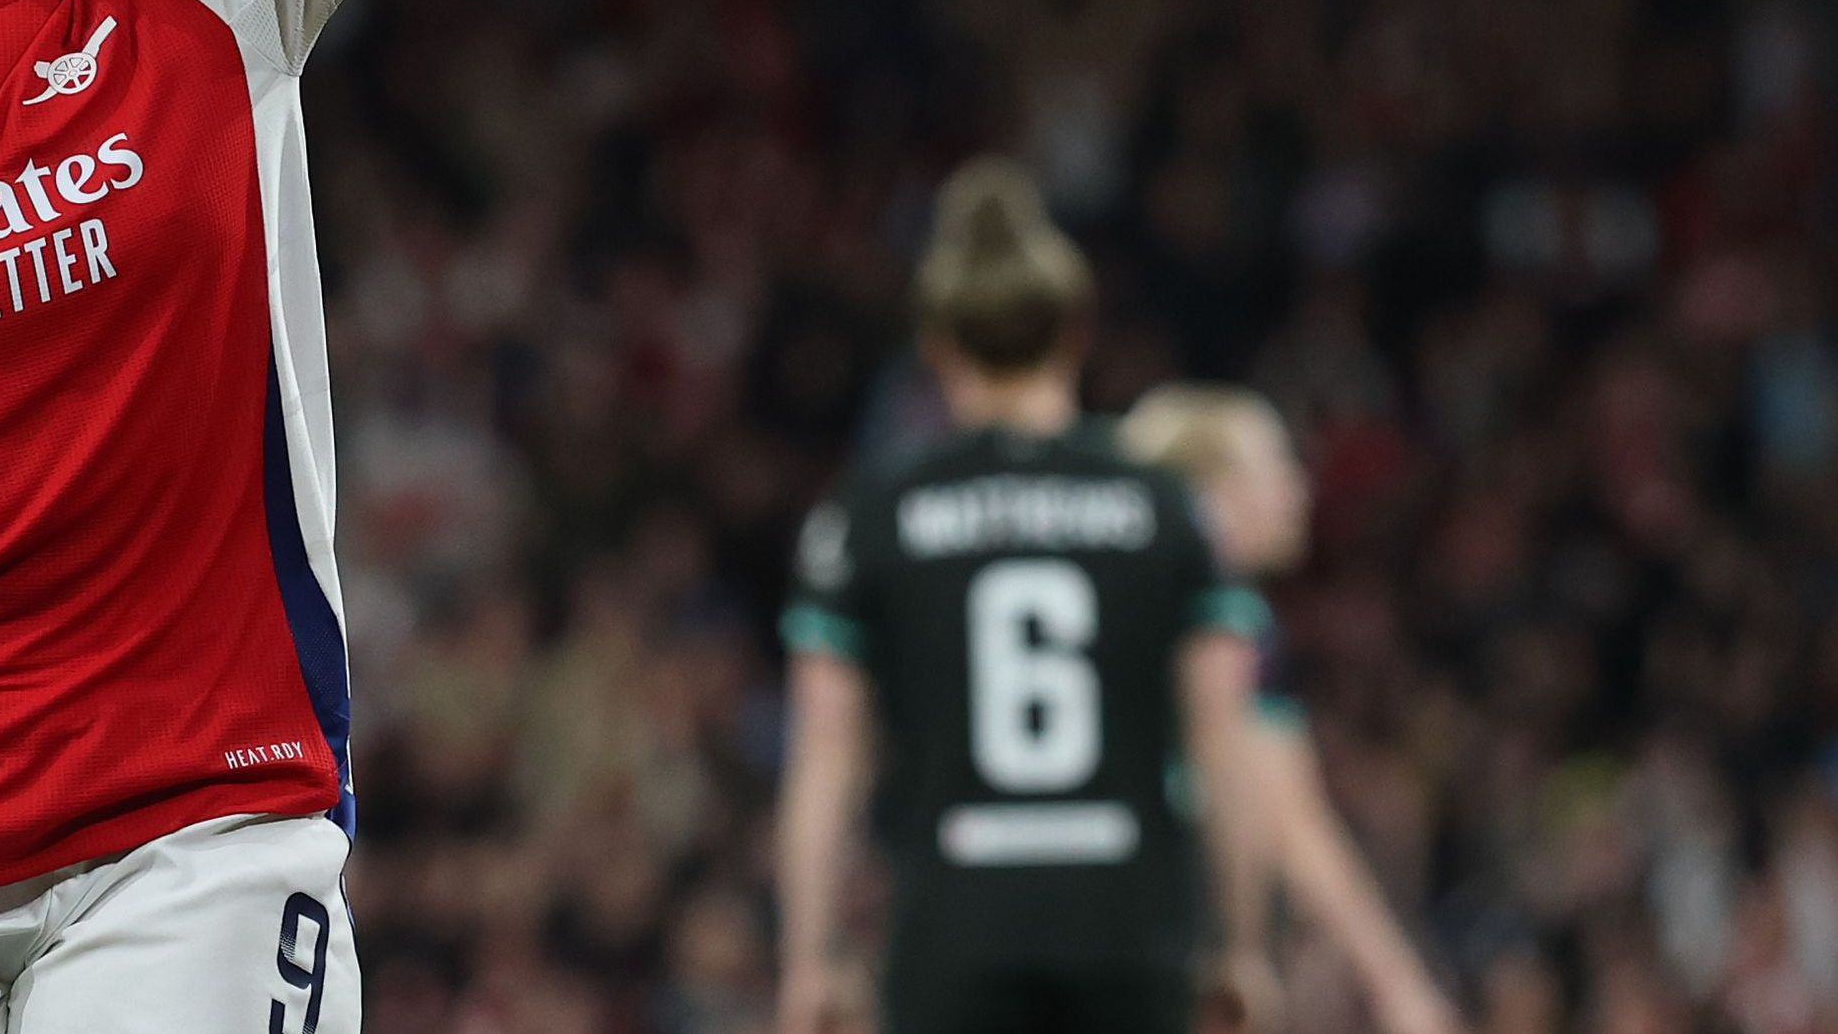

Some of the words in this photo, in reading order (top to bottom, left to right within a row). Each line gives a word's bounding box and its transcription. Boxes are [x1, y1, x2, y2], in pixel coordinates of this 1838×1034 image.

[968, 559, 1102, 794] 6
[224, 741, 303, 769] HEAT.RDY
[269, 892, 330, 1034] 9
